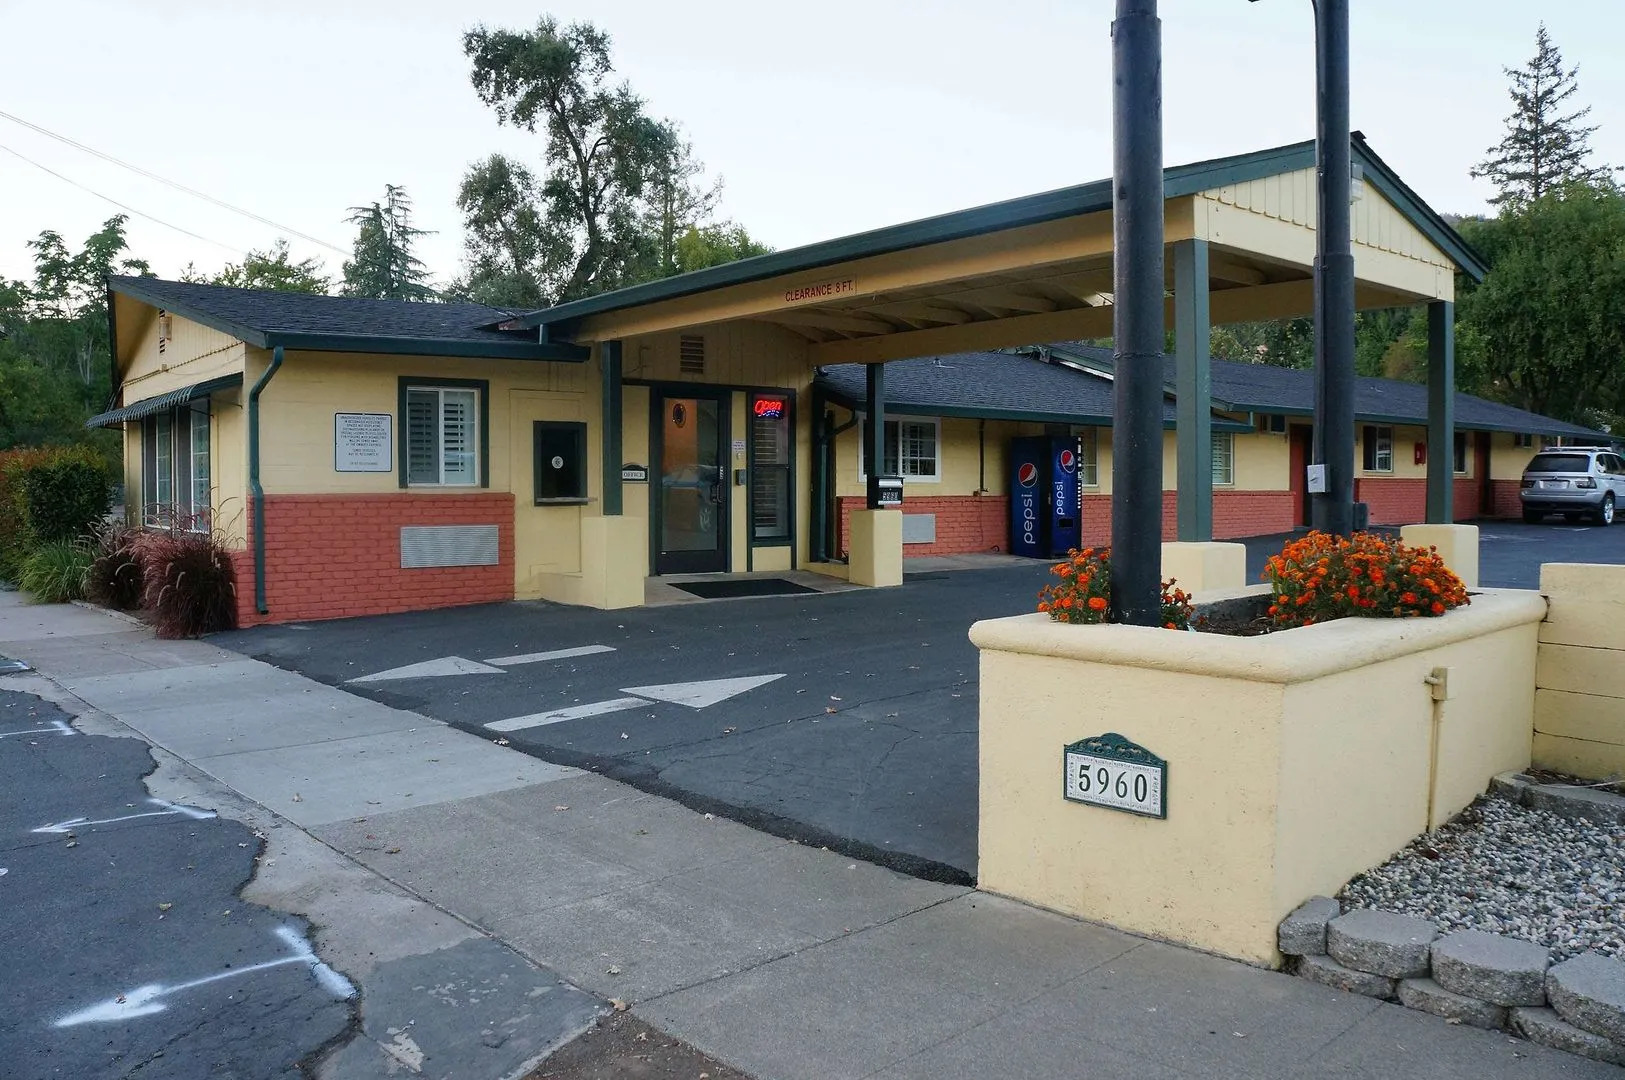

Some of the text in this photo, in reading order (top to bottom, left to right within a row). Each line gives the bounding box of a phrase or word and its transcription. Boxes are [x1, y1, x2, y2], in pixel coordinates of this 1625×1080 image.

[785, 280, 853, 302] CLEARANCE 8 FT.
[754, 400, 782, 415] Open
[1054, 481, 1065, 516] pepsi
[1021, 492, 1036, 545] pepsi
[1078, 764, 1148, 803] 5960
